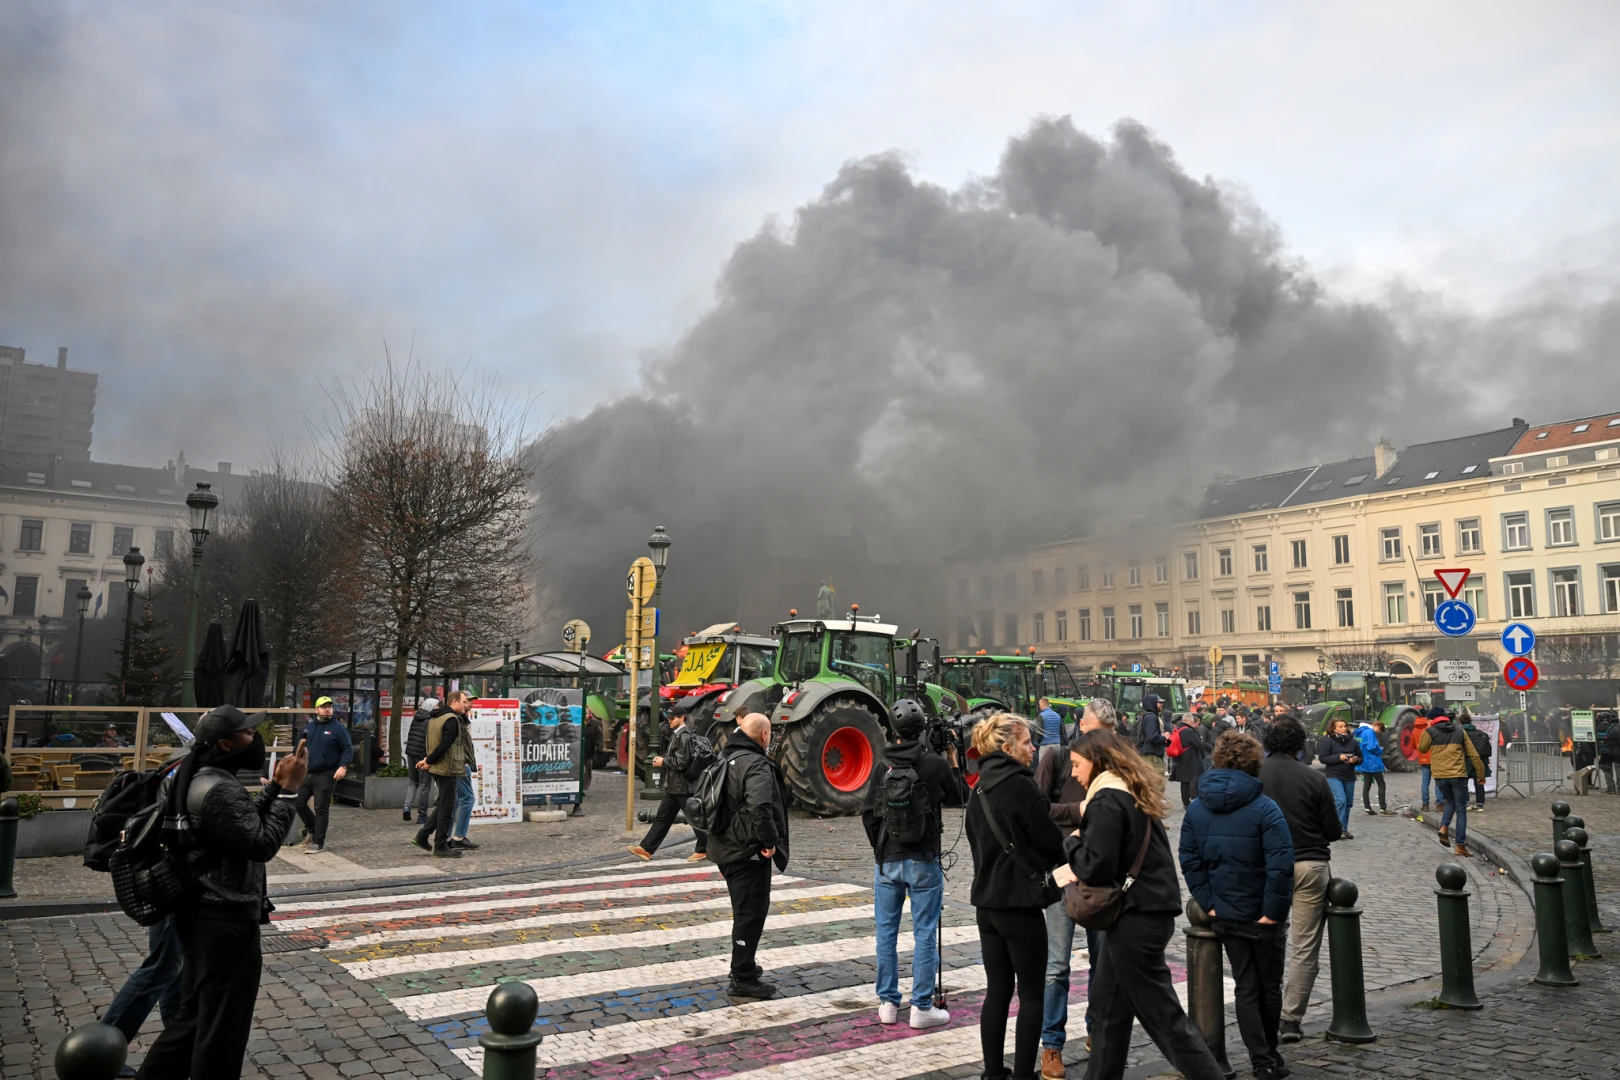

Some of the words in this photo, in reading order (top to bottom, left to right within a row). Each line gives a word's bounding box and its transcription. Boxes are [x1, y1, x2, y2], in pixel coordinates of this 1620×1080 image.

[1134, 664, 1139, 672] P
[1272, 662, 1276, 670] P
[521, 740, 570, 761] LÉOPÂTRE
[521, 761, 573, 778] uperstar
